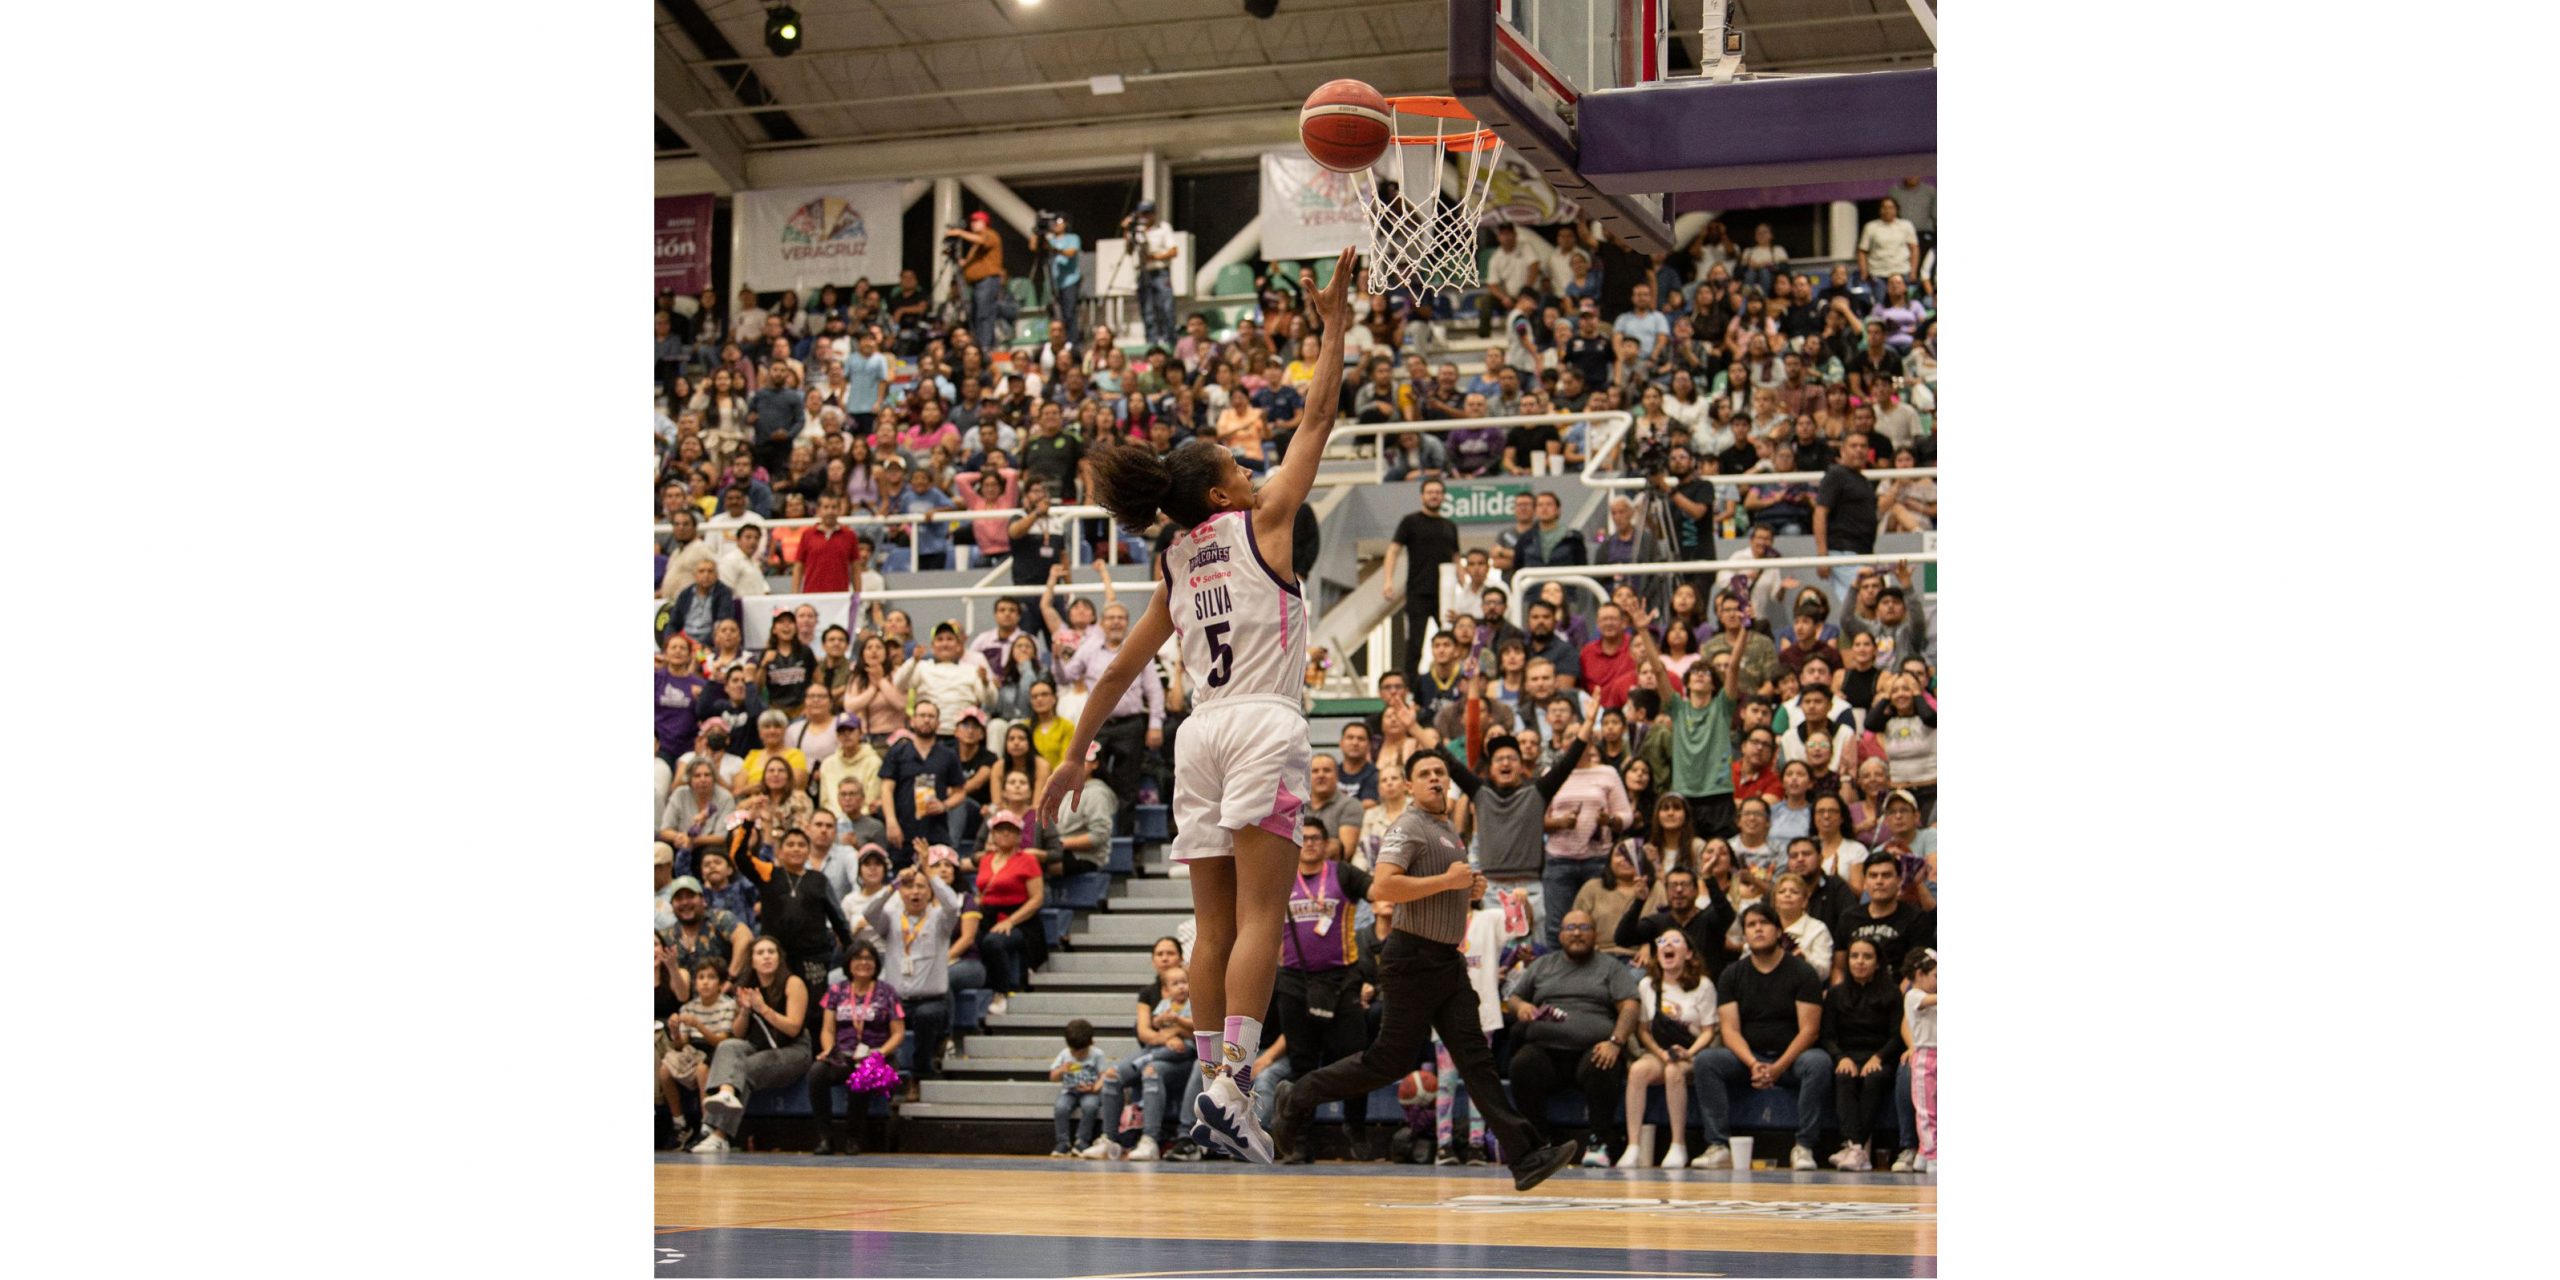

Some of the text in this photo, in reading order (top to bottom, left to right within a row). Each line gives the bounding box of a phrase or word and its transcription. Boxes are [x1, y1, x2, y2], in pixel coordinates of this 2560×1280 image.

[781, 242, 867, 260] VERACRUZ
[1438, 490, 1516, 519] Salida
[1194, 584, 1232, 620] SILVA
[1204, 620, 1233, 688] 5
